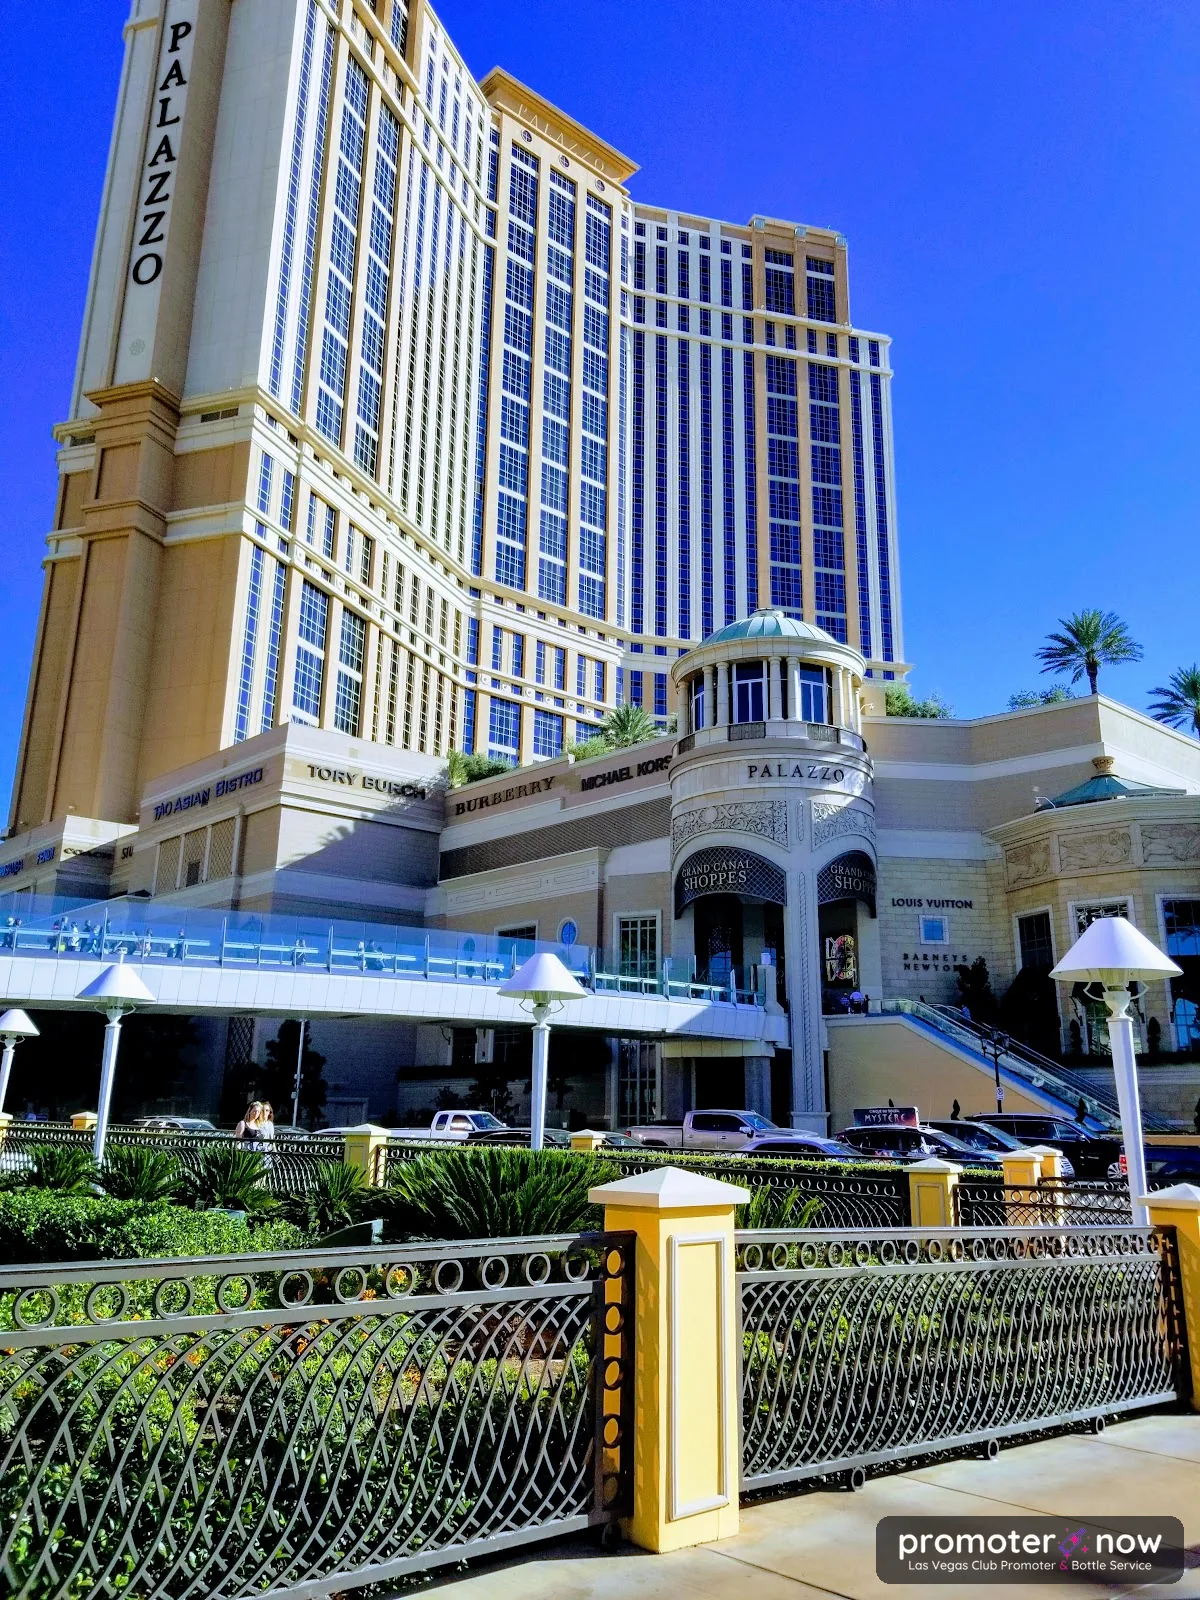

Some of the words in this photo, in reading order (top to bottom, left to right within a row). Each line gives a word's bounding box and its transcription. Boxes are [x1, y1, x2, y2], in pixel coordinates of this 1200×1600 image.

[132, 21, 192, 285] PALAZZO
[307, 763, 358, 786] TORY
[362, 776, 426, 800] BURCH
[581, 767, 633, 791] MICHAEL
[637, 755, 673, 777] KORS
[747, 764, 845, 782] PALAZZO
[153, 801, 173, 821] TAO
[173, 788, 211, 813] ASIAN
[215, 768, 264, 797] BISTRO
[455, 776, 555, 815] BURBERRY
[682, 864, 710, 877] GRAND
[713, 860, 753, 873] CANAL
[830, 864, 863, 877] GRAND
[684, 871, 747, 890] SHOPPES
[892, 898, 923, 907] LOUIS
[926, 899, 973, 909] VUITTON
[903, 953, 968, 962] BARNEYS
